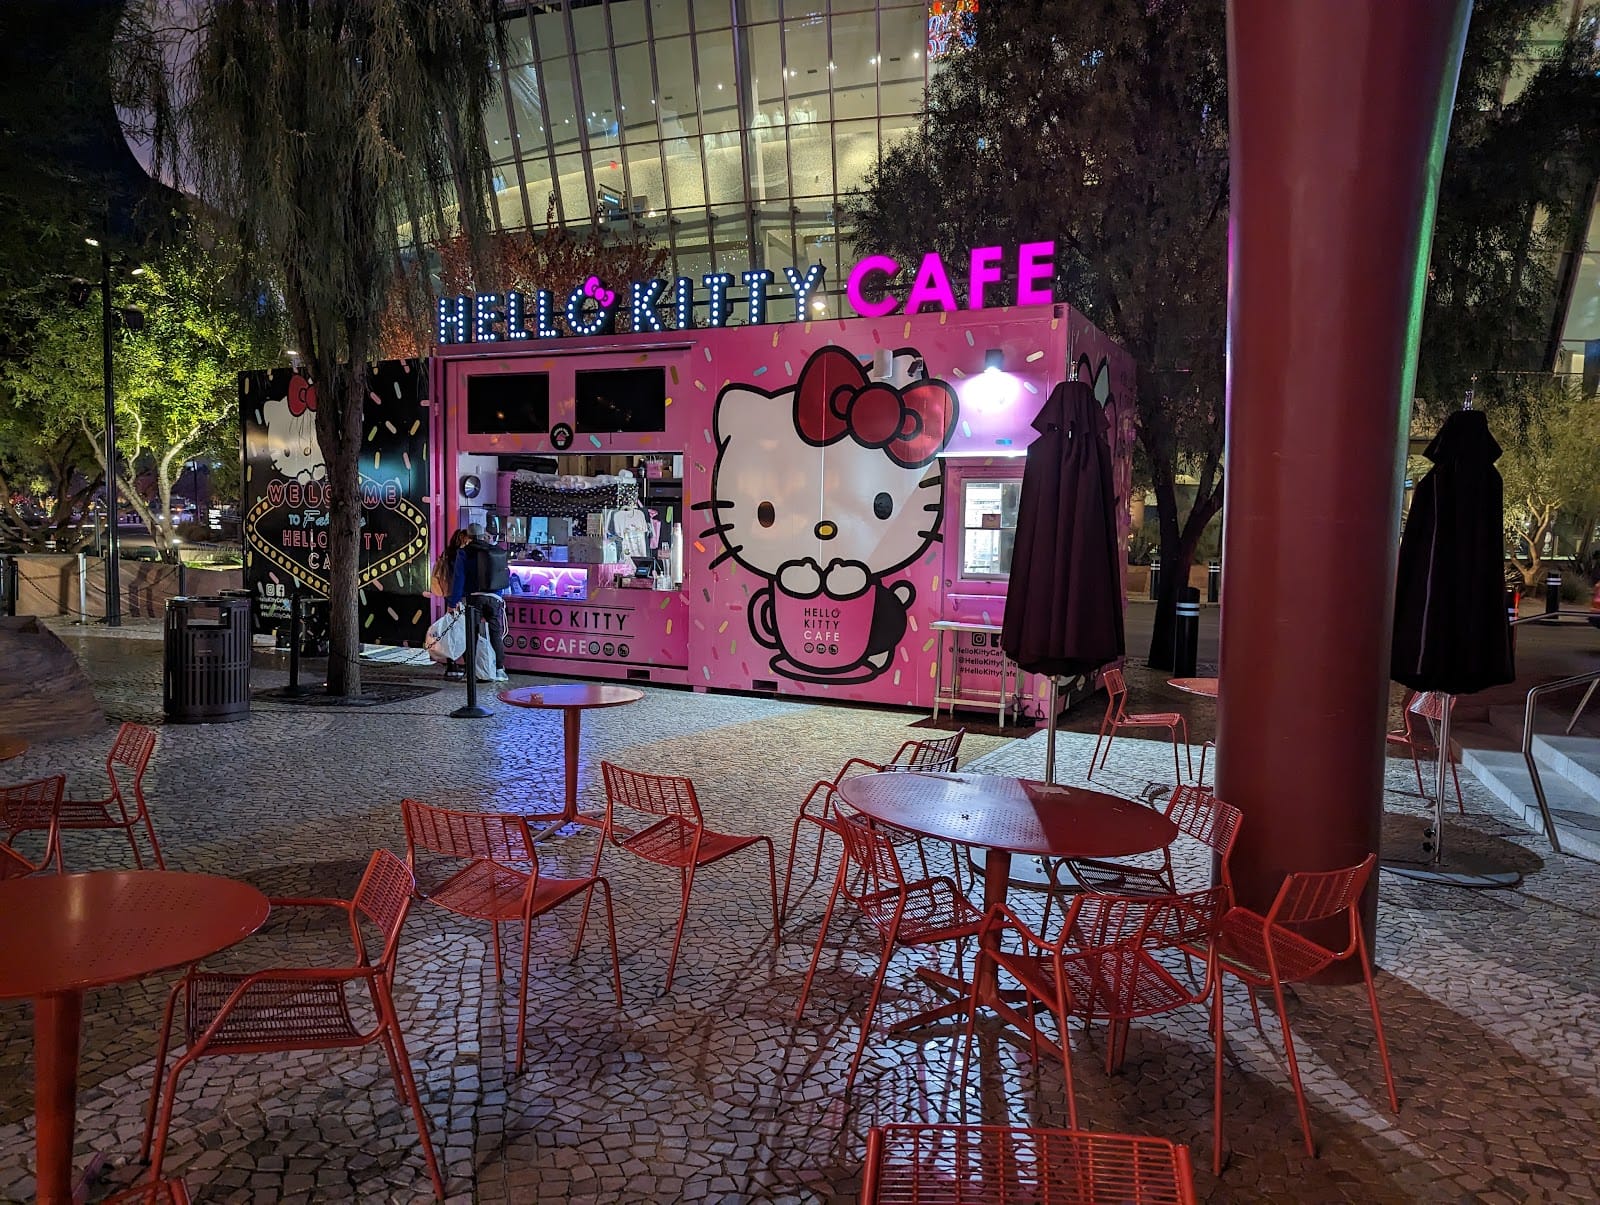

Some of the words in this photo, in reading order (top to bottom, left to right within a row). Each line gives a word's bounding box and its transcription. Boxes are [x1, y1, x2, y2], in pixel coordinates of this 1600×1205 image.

[438, 281, 610, 344] HELLO
[631, 264, 826, 332] KITTY
[847, 241, 1054, 318] CAFE
[269, 485, 397, 505] WELCME
[282, 530, 328, 549] HELLO
[308, 552, 331, 570] CA
[506, 607, 562, 626] HELLO
[570, 611, 626, 631] KITTY
[804, 608, 840, 618] HELLO
[804, 620, 840, 630] KITTY
[543, 636, 587, 655] CAFE
[804, 631, 840, 641] CAFE
